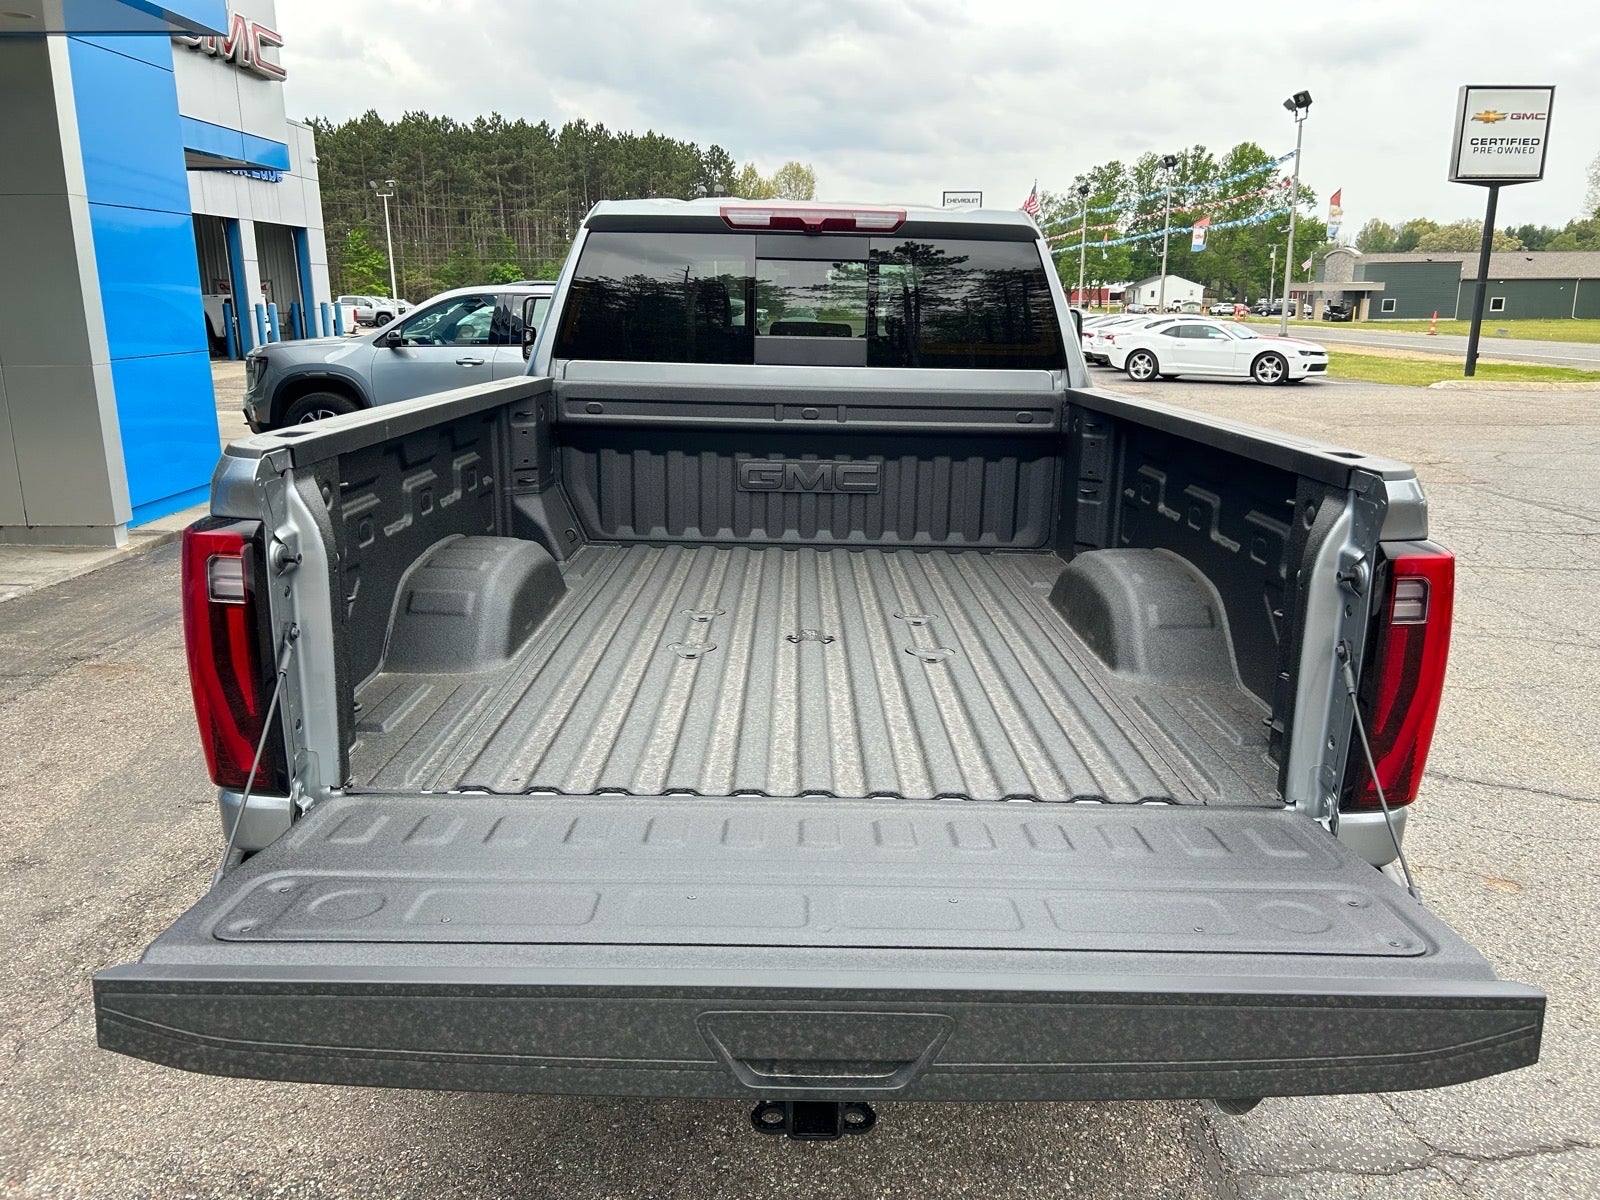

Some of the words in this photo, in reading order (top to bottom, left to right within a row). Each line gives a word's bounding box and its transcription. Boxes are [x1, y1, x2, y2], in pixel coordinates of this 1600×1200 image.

[172, 12, 287, 81] MC
[1510, 112, 1546, 121] GMC
[1470, 138, 1541, 146] CERTIFIED
[1473, 147, 1536, 155] PRE-OWNED
[945, 197, 979, 205] CHEVROLET
[738, 462, 879, 491] GMC
